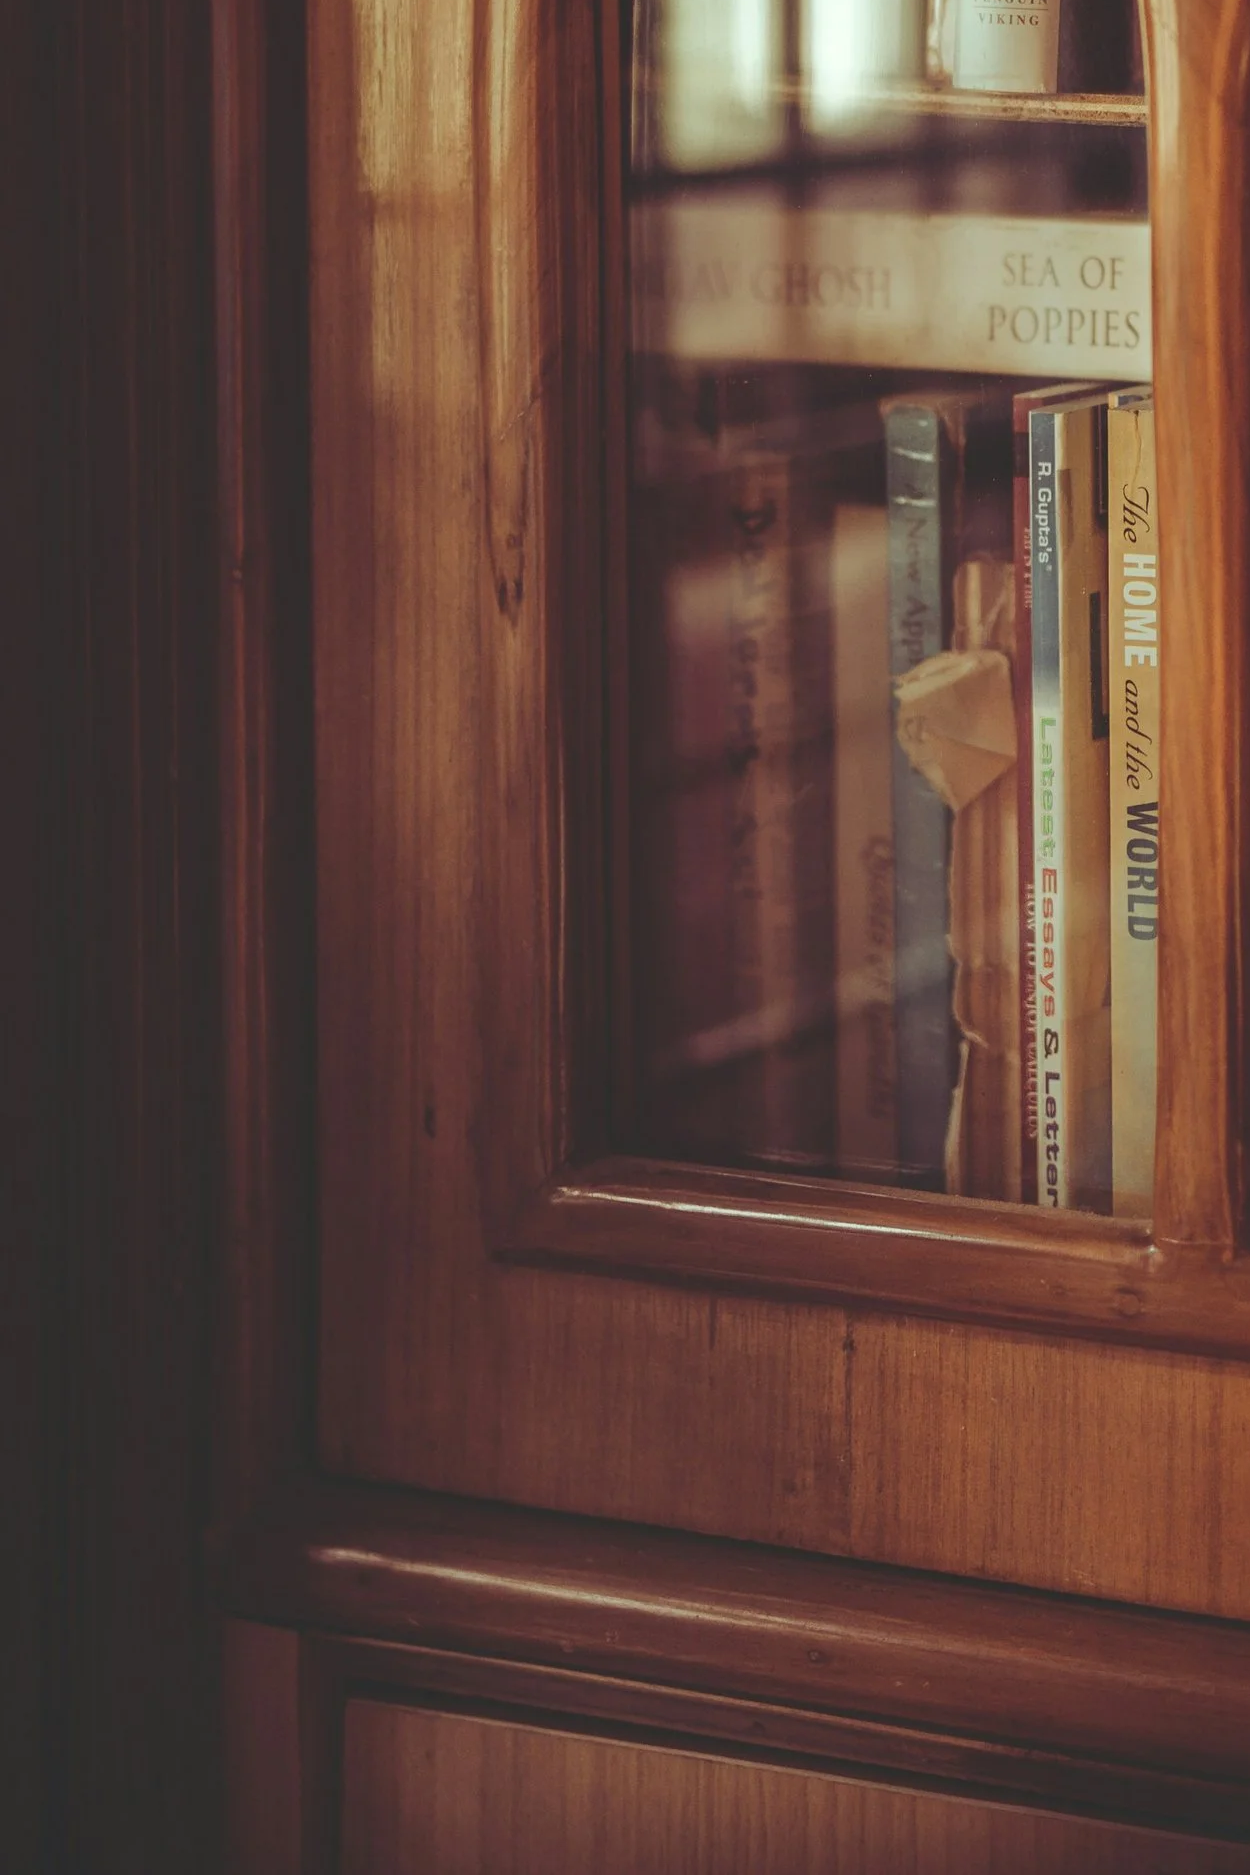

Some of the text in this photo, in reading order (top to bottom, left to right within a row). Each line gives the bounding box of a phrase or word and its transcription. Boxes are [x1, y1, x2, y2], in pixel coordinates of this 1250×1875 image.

[978, 12, 1041, 27] VIKING
[1002, 252, 1125, 292] SEA OF
[988, 305, 1142, 350] POPPIES
[1037, 462, 1053, 482] R.
[1122, 483, 1159, 941] The HOME and the WORLD
[1039, 717, 1061, 1208] Latest Essays & Letter
